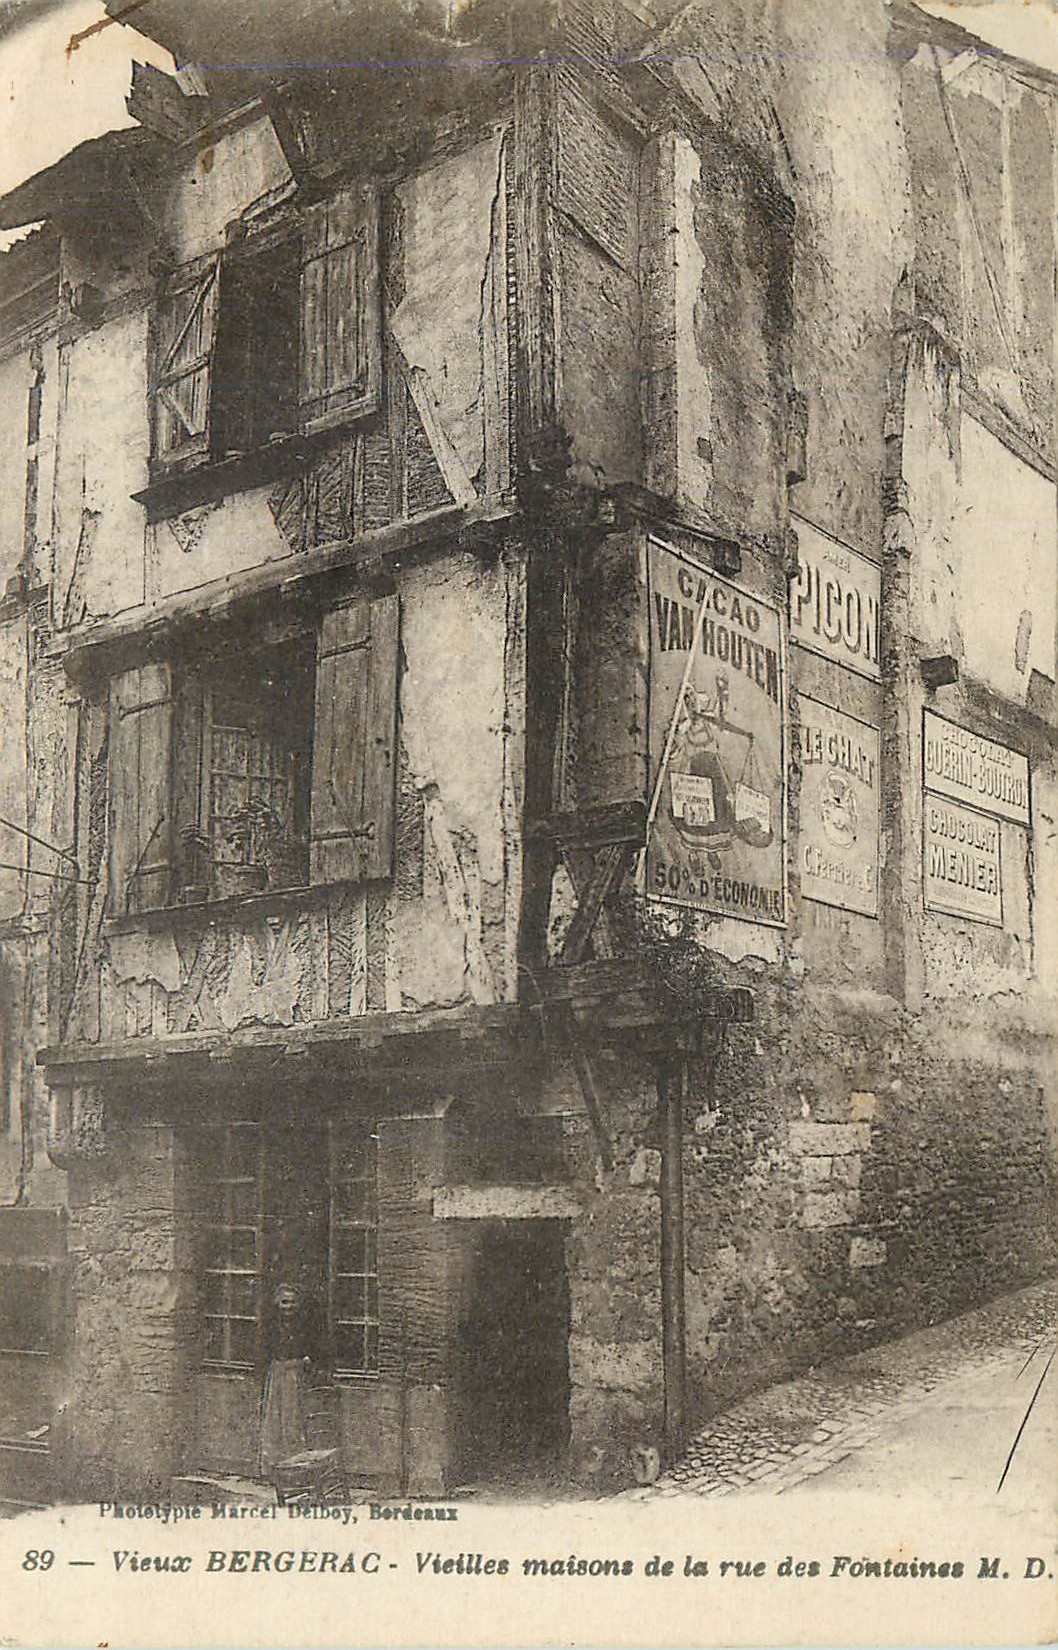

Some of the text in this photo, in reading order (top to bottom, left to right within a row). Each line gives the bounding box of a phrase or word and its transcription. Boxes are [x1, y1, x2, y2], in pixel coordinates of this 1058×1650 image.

[678, 568, 760, 632] CACAO
[789, 558, 879, 665] PICON
[655, 592, 778, 703] VAN HOUTEN
[801, 726, 875, 789] LE CHAT
[941, 723, 1013, 768] CHOCOLAT
[928, 808, 997, 854] CHOCOLAT
[655, 861, 696, 895] 50%
[928, 841, 998, 896] MENIER
